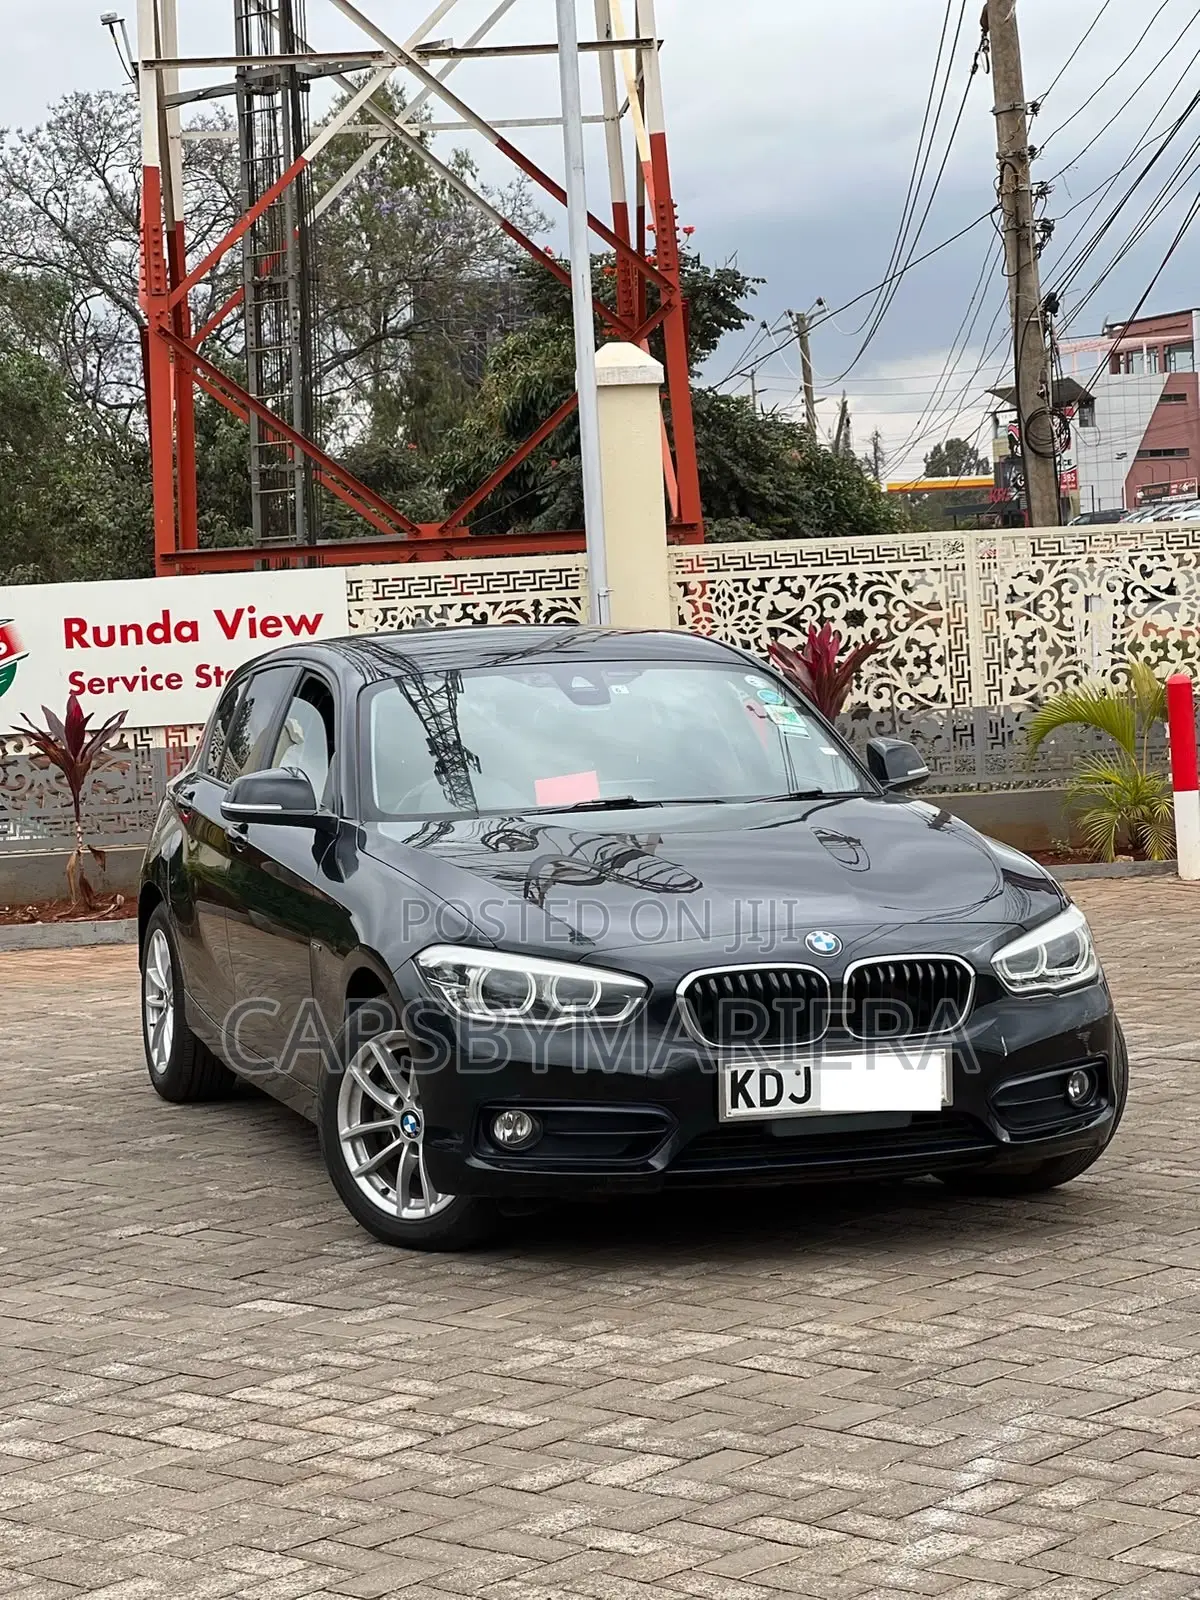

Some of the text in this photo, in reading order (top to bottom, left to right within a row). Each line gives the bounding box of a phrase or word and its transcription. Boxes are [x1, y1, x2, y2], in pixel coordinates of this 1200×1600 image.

[63, 605, 324, 649] Runda View
[68, 664, 234, 695] Service St
[730, 1065, 813, 1110] KDJ
